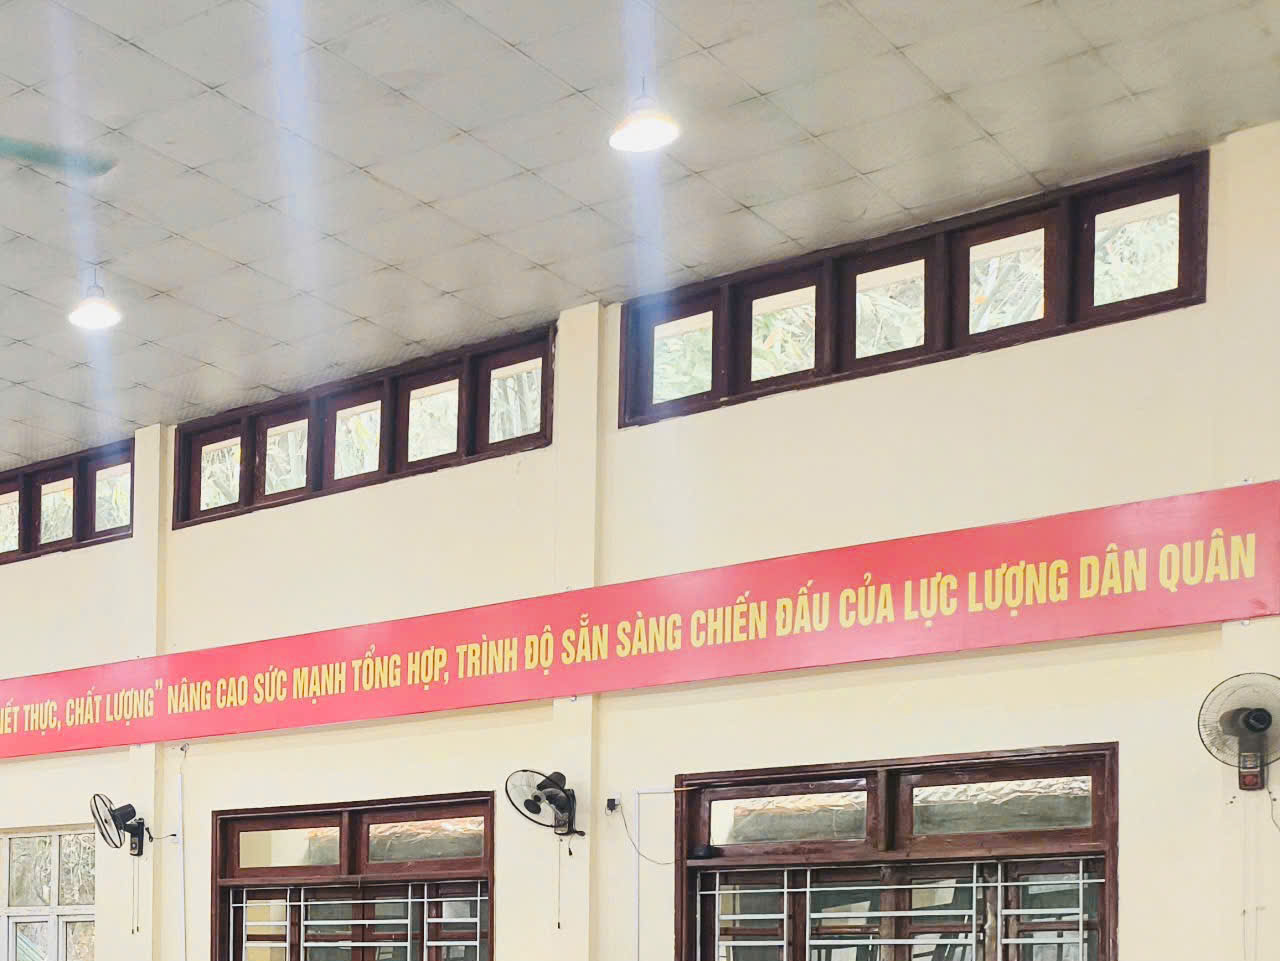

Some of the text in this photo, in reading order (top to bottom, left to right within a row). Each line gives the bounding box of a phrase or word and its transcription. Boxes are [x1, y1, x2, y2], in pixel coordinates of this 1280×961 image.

[23, 698, 62, 736] THỰC,
[65, 686, 102, 727] CHẤT
[167, 677, 212, 715] NÂNG
[216, 675, 249, 709] CAO
[253, 665, 288, 705] SỨC
[292, 661, 347, 704] MẠNH
[351, 643, 402, 692] TỔNG
[407, 645, 449, 691] HỢP,
[455, 634, 518, 679] TRÌNH
[524, 624, 555, 676] ĐỘ
[560, 612, 609, 665] SẴN
[616, 611, 682, 658] SÀNG
[690, 590, 768, 648] CHIẾN
[775, 579, 830, 637] ĐẤU
[838, 571, 895, 629] CỦA
[903, 571, 958, 628] LỰC
[968, 559, 1069, 617] LƯỢNG
[1079, 543, 1147, 599] DÂN
[1158, 527, 1257, 593] QUÂN
